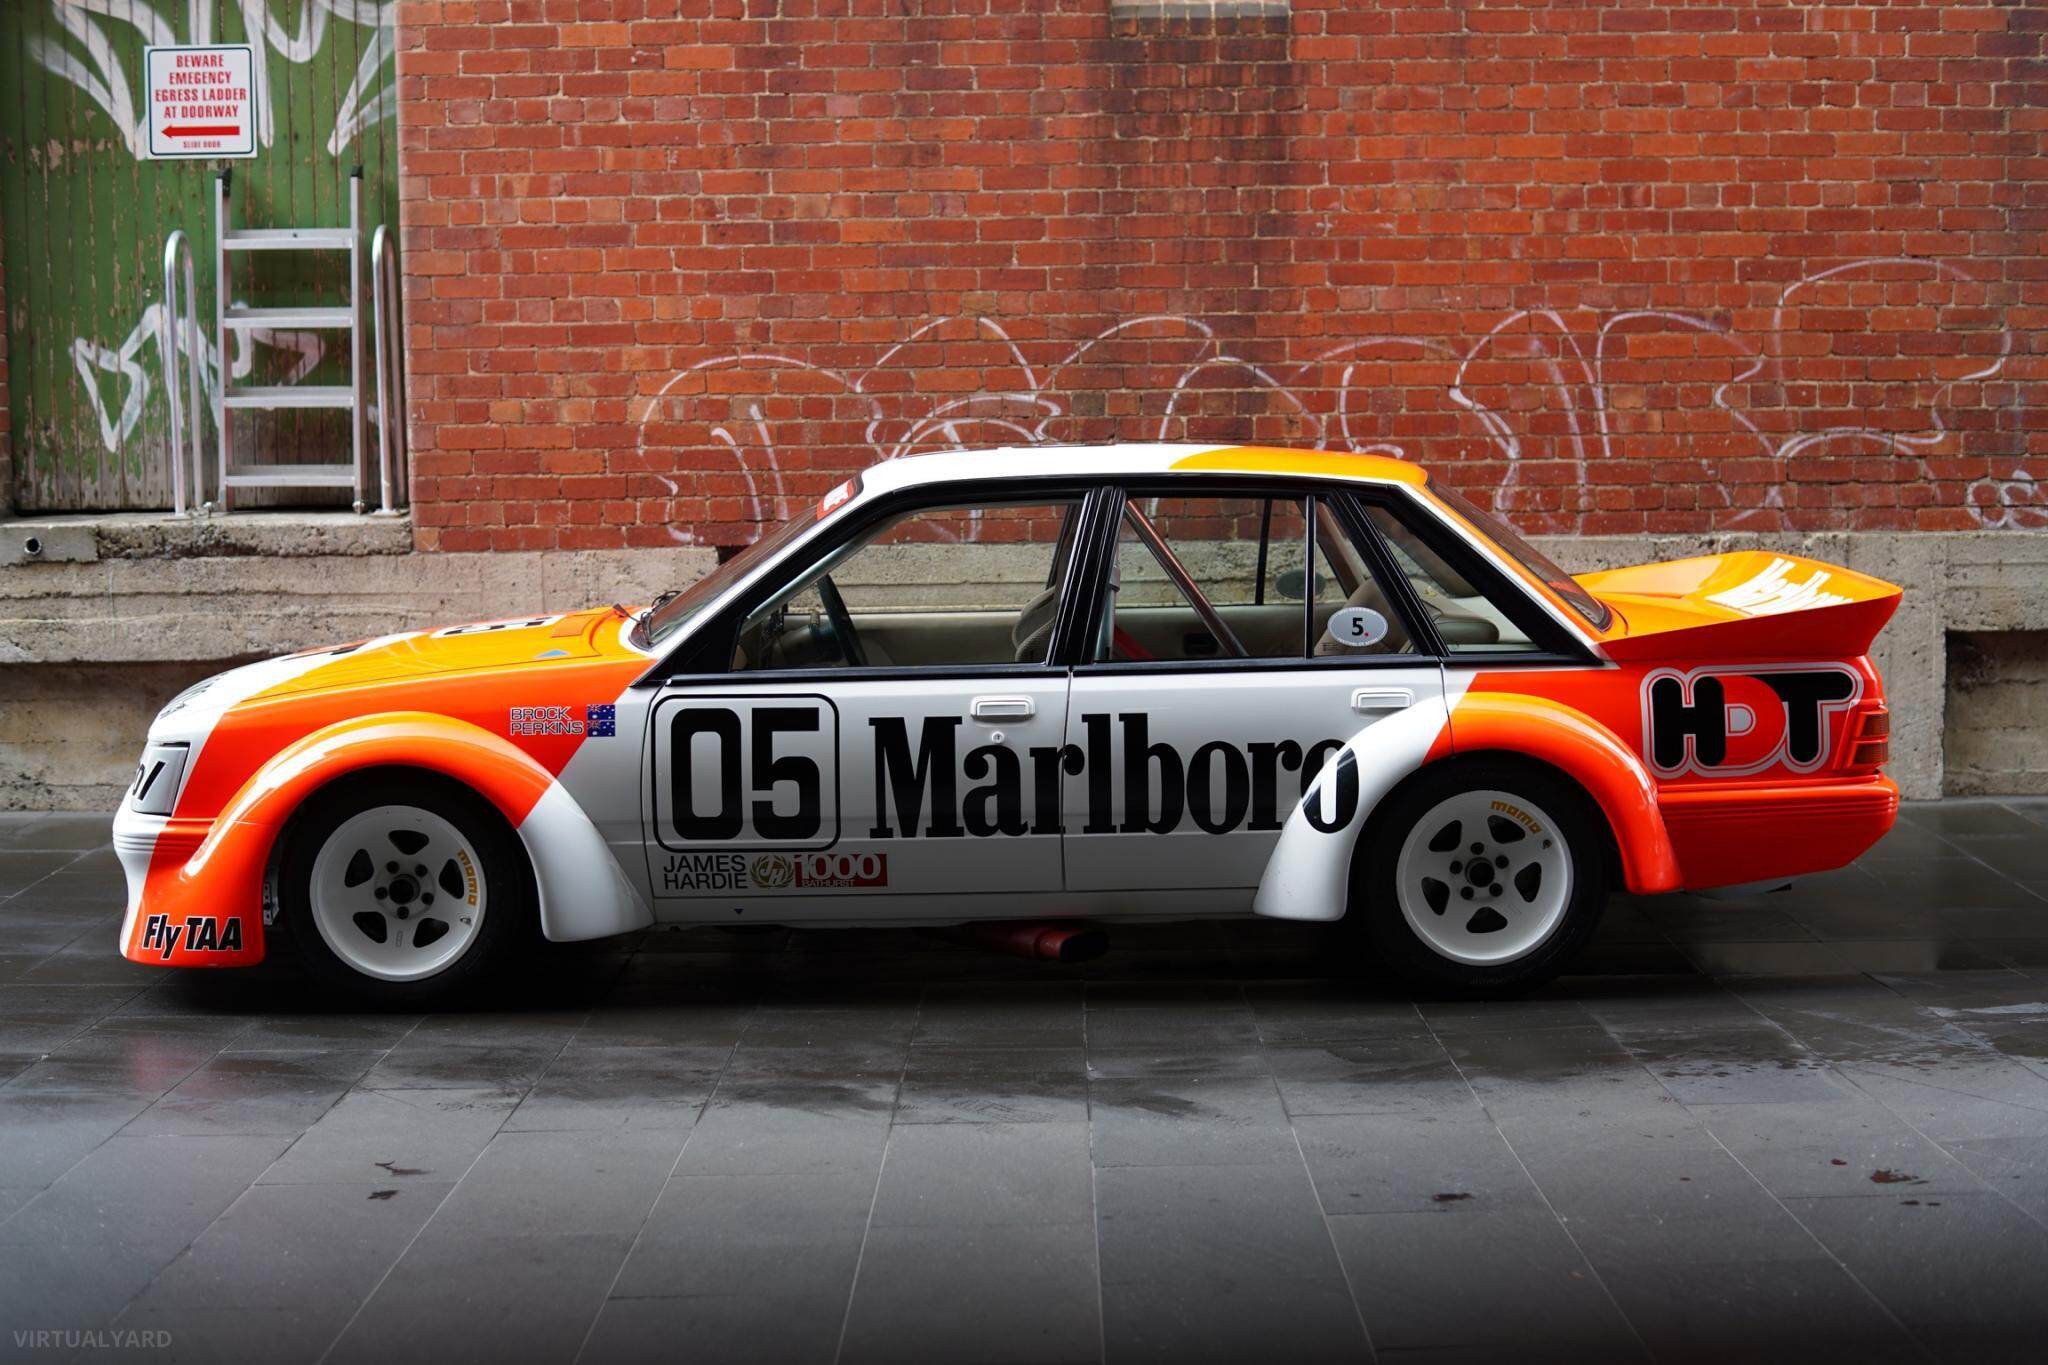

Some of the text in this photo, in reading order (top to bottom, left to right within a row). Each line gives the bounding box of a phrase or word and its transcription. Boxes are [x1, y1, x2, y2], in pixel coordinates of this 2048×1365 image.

[176, 54, 224, 68] BEWARE
[169, 71, 232, 85] EMEGENCY
[155, 87, 247, 102] EGRESS LADDER
[163, 104, 239, 119] AT DOORWAY
[510, 706, 572, 721] BROCK
[1646, 667, 1858, 773] HDT
[510, 720, 585, 735] PERKINS
[670, 707, 821, 840] 05
[868, 712, 1360, 839] Marlboro
[1490, 800, 1542, 834] momo
[663, 855, 747, 873] JAMES
[795, 852, 882, 881] 1000
[457, 848, 478, 907] momo
[664, 872, 748, 890] HARDIE
[801, 878, 855, 888] BATHURST
[142, 913, 243, 960] Fly TAA
